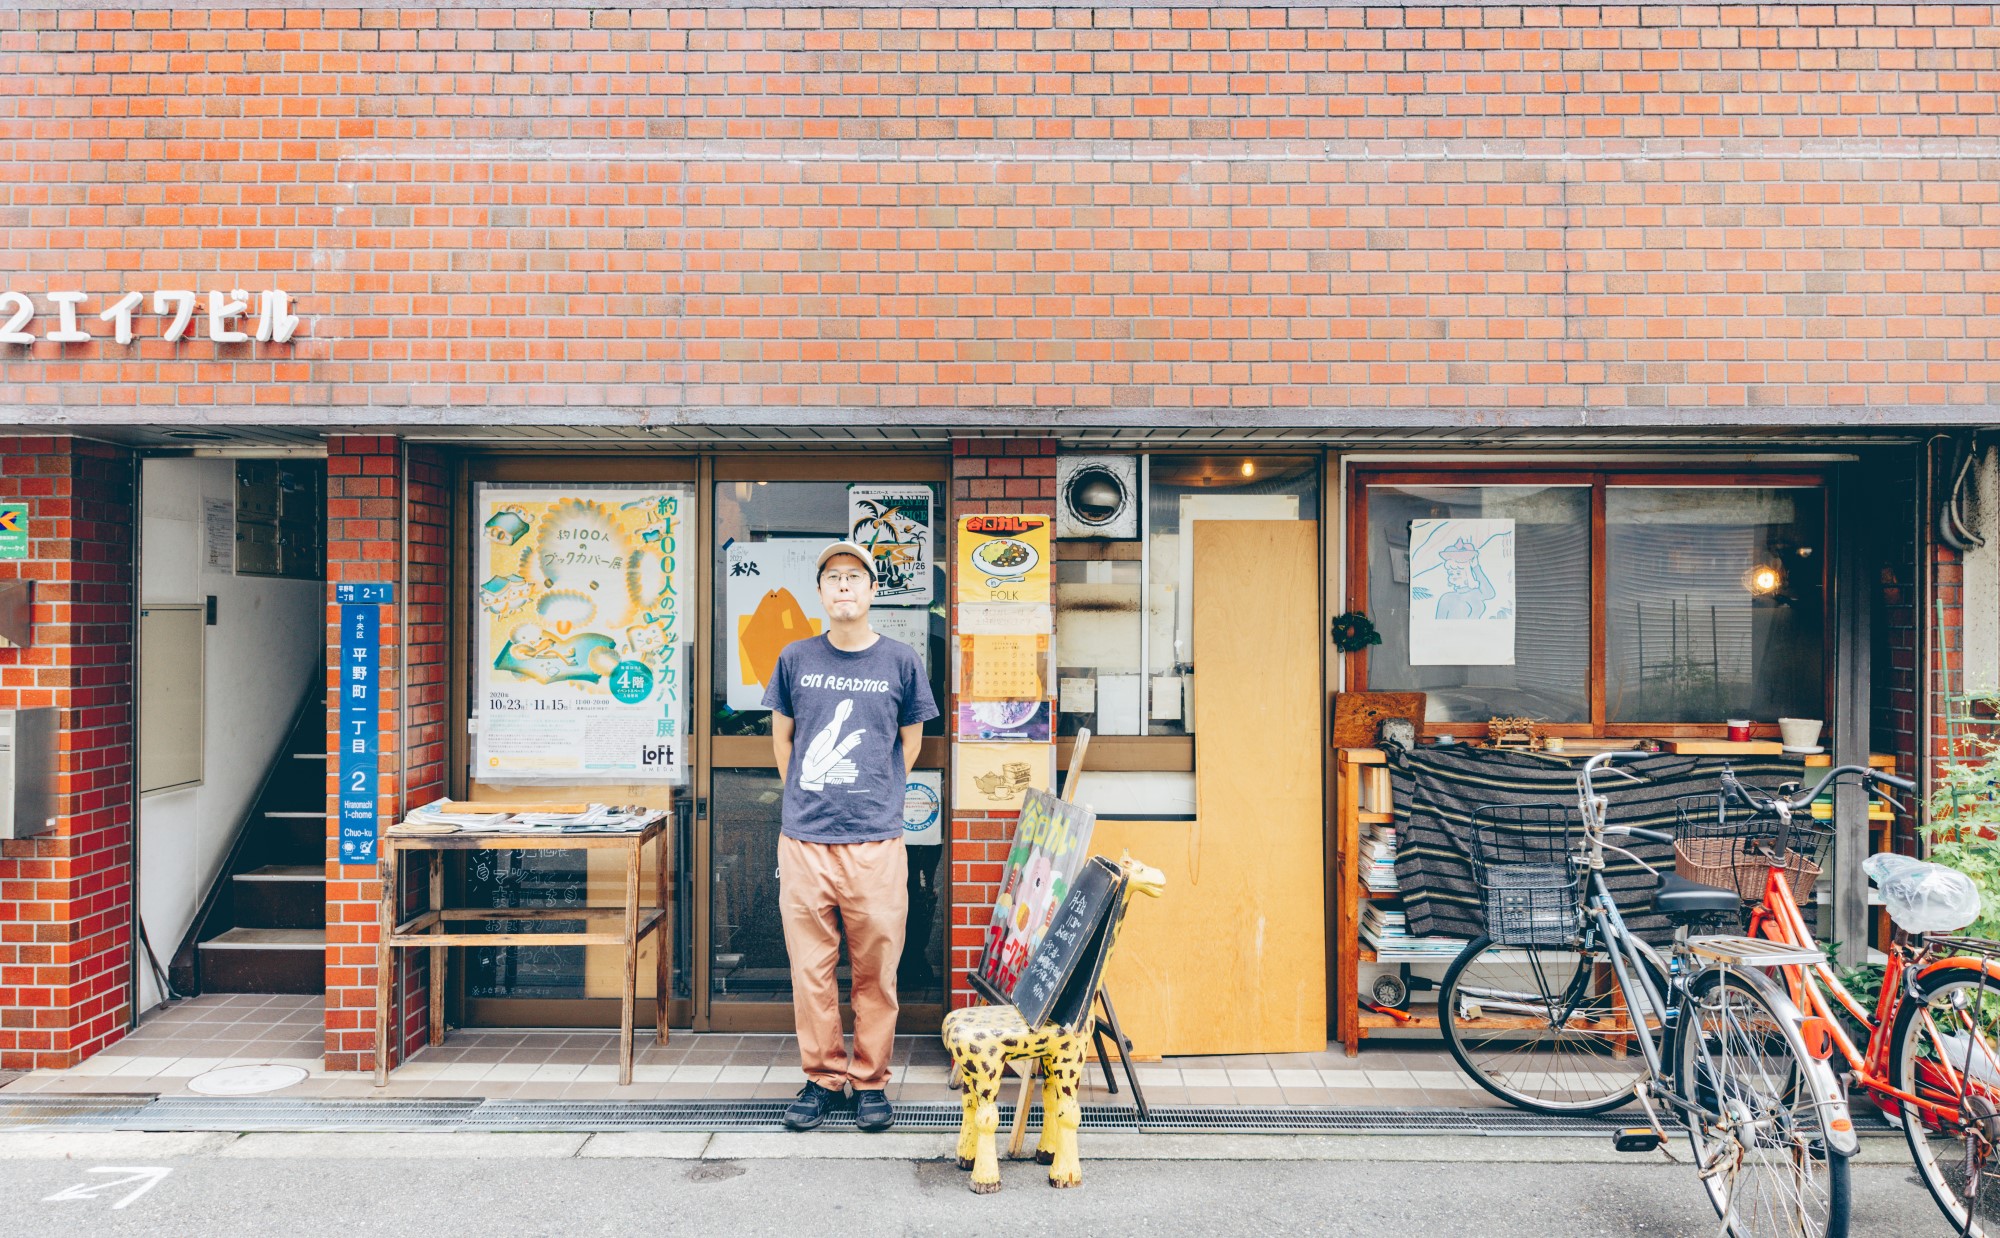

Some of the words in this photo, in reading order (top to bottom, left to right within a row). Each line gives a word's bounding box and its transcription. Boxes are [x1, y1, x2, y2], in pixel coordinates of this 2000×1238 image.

[883, 495, 930, 506] PLANET
[895, 510, 928, 521] SPICE
[967, 516, 1044, 531] 谷口カレー
[557, 528, 609, 541] 約100人
[544, 552, 623, 570] ブックカバー展
[903, 562, 925, 571] 11/26
[730, 561, 760, 576] 秋
[363, 588, 384, 598] 2-1
[990, 590, 1018, 600] FOLK
[356, 613, 365, 639] 中央区
[617, 670, 645, 689] 4階
[800, 674, 824, 688] ON
[824, 676, 890, 693] READING
[352, 648, 367, 753] 平野町一丁目
[351, 771, 366, 791] 2
[344, 800, 373, 809] Hiranomachi
[344, 810, 373, 819] 1-chome
[344, 828, 373, 837] Chuo-ku
